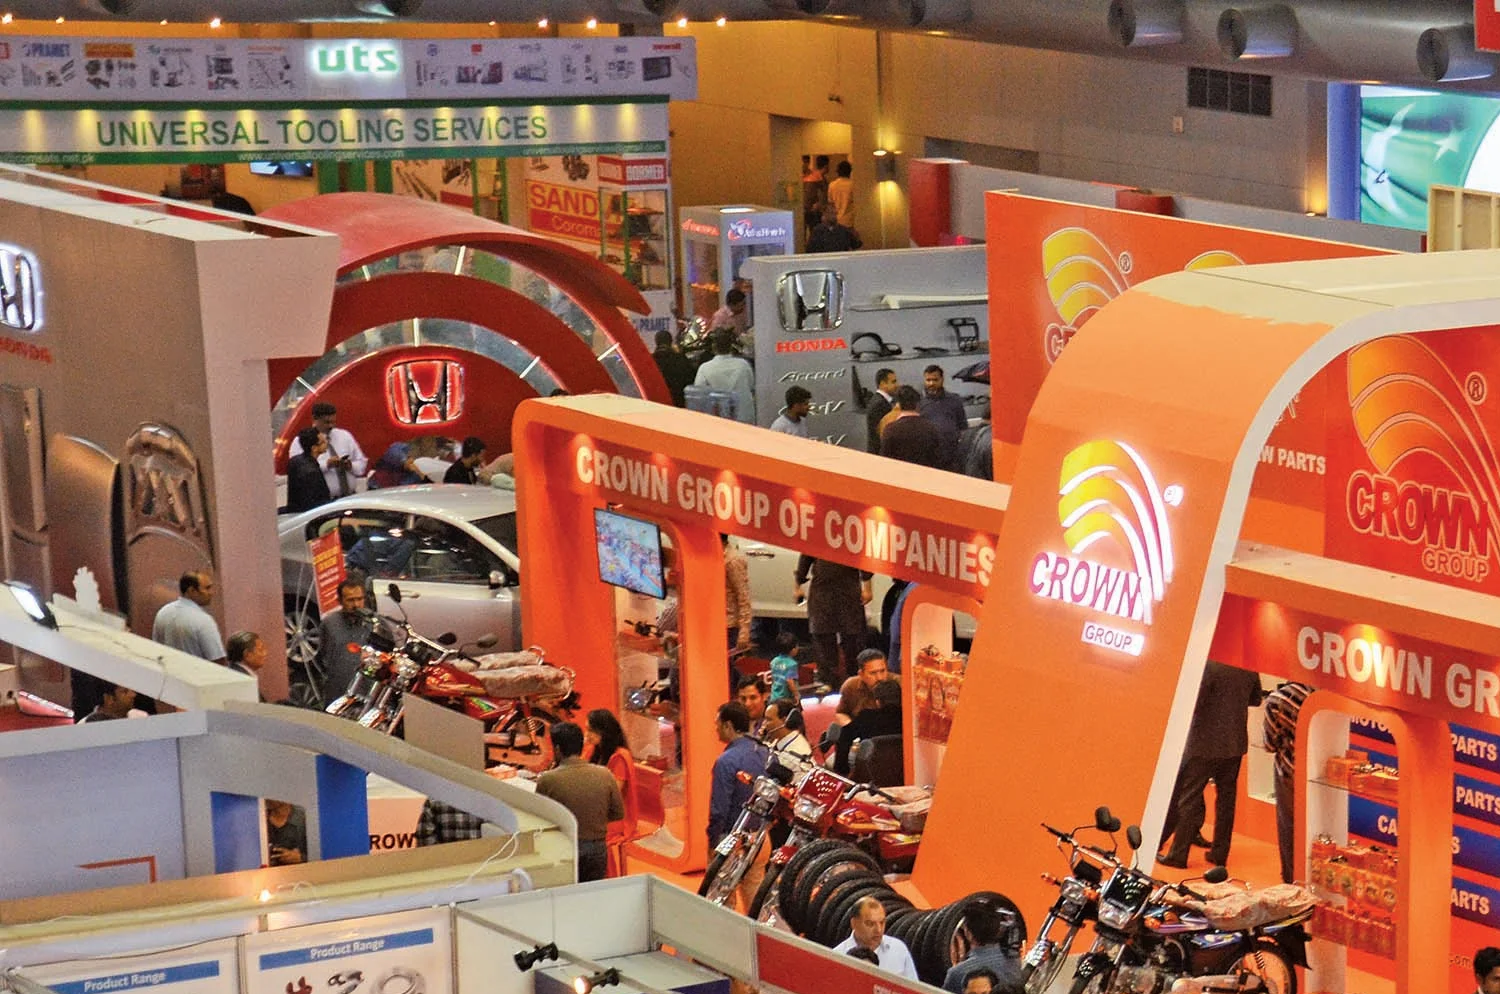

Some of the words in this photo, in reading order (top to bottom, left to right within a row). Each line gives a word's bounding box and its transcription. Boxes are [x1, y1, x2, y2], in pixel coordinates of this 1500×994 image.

[317, 42, 399, 74] uts
[97, 117, 269, 147] UNIVERSAL
[277, 117, 404, 146] TOOLING
[413, 114, 548, 143] SERVICES
[775, 337, 848, 353] HONDA
[1277, 447, 1327, 476] PARTS
[576, 444, 669, 503] CROWN
[677, 471, 769, 529] GROUP
[778, 498, 816, 542] OF
[824, 509, 996, 588] COMPANIES
[1346, 470, 1494, 559] CROWN
[1421, 547, 1490, 582] GROUP
[1027, 551, 1152, 625] CROWN
[1083, 623, 1143, 656] GROUP
[1296, 626, 1432, 699] CROWN
[1451, 733, 1498, 762] PARTS
[369, 832, 416, 850] ROW
[1451, 891, 1491, 916] ARTS
[310, 945, 348, 960] Product
[352, 938, 386, 955] Range
[84, 977, 126, 993] Product
[131, 970, 166, 988] Range
